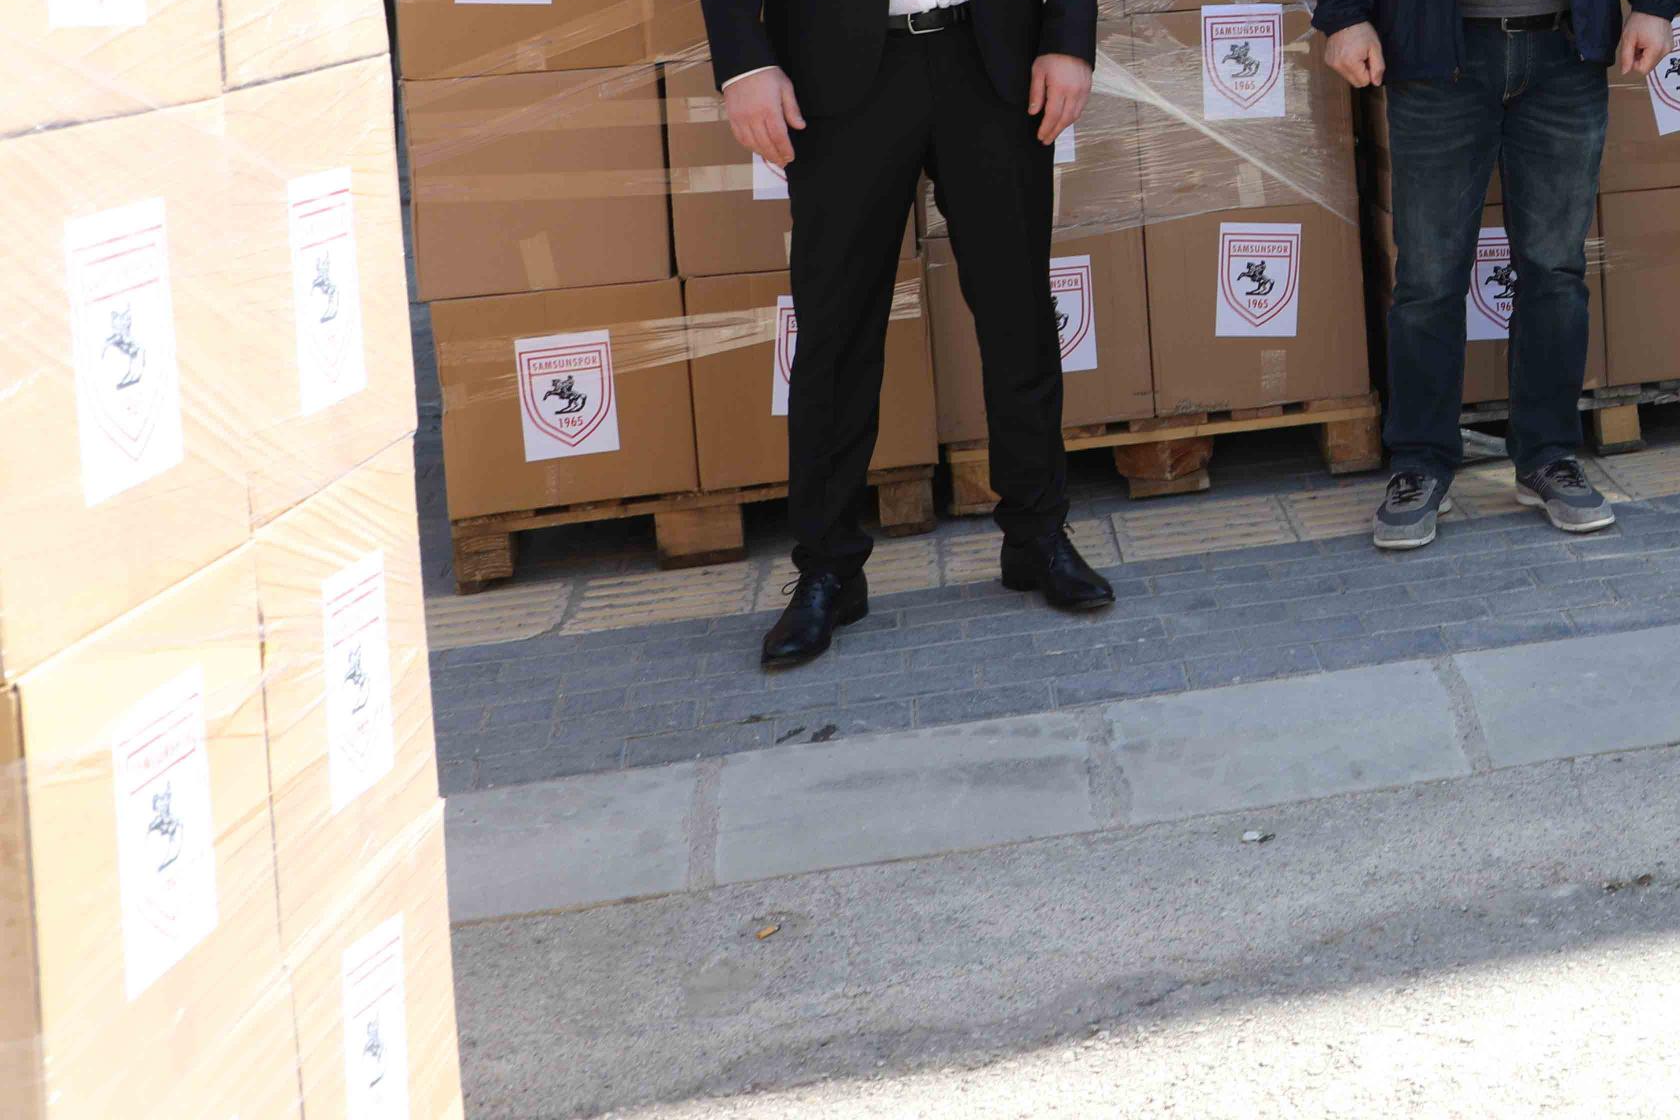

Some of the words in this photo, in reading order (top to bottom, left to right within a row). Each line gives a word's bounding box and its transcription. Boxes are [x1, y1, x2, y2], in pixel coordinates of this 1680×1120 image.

[1214, 24, 1271, 37] SAMSUNSPOR
[1233, 79, 1256, 92] 1965
[1231, 243, 1290, 256] SAMSUNSPOR
[1247, 298, 1268, 310] 1965
[532, 355, 599, 372] SAMSUNSPOR
[558, 415, 584, 429] 1965
